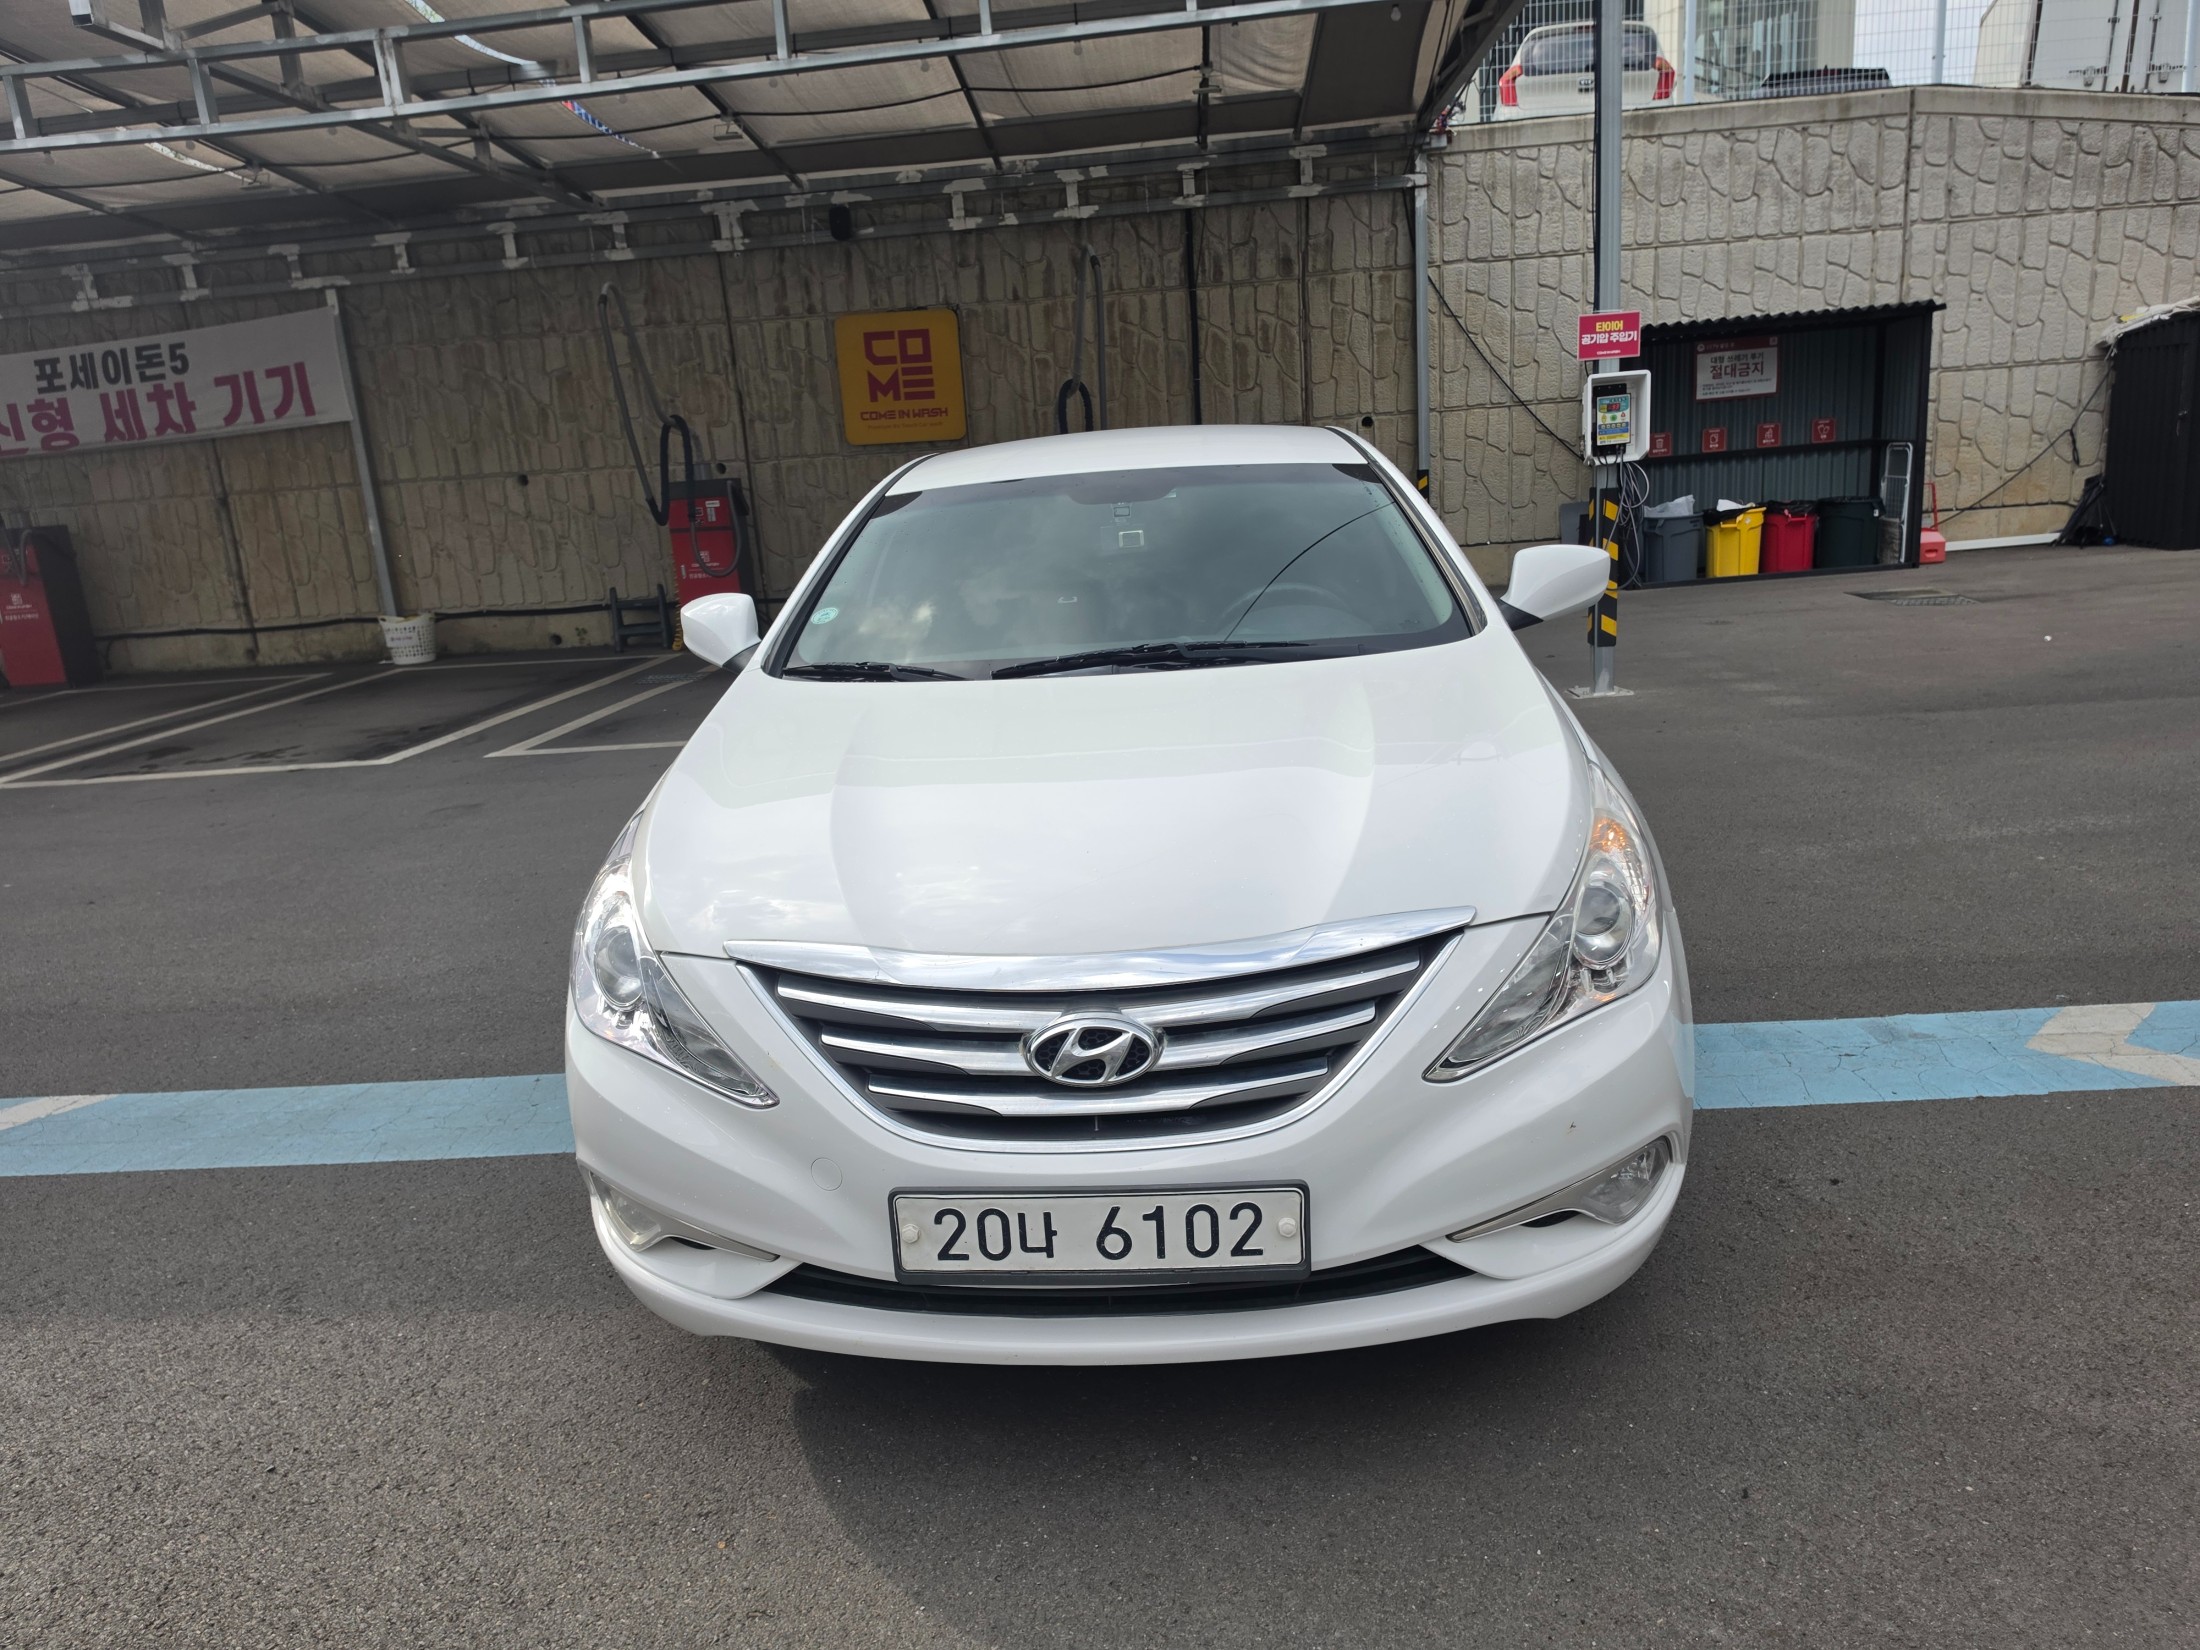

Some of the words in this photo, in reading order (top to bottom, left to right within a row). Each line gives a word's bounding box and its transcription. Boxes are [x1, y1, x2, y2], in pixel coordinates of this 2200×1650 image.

[1595, 319, 1624, 332] 타이어
[1581, 332, 1609, 345] 공기압
[1609, 330, 1638, 343] 주입기
[1727, 353, 1749, 363] 쓰레기
[33, 342, 190, 394] 포세이돈5
[1710, 361, 1764, 380] 절대금지
[99, 381, 197, 442] 세차
[213, 361, 316, 427] 기기
[860, 410, 897, 421] COME
[898, 409, 910, 419] IN
[912, 407, 949, 418] WASH
[934, 1207, 1058, 1261] 20나
[1095, 1201, 1264, 1260] 6102
